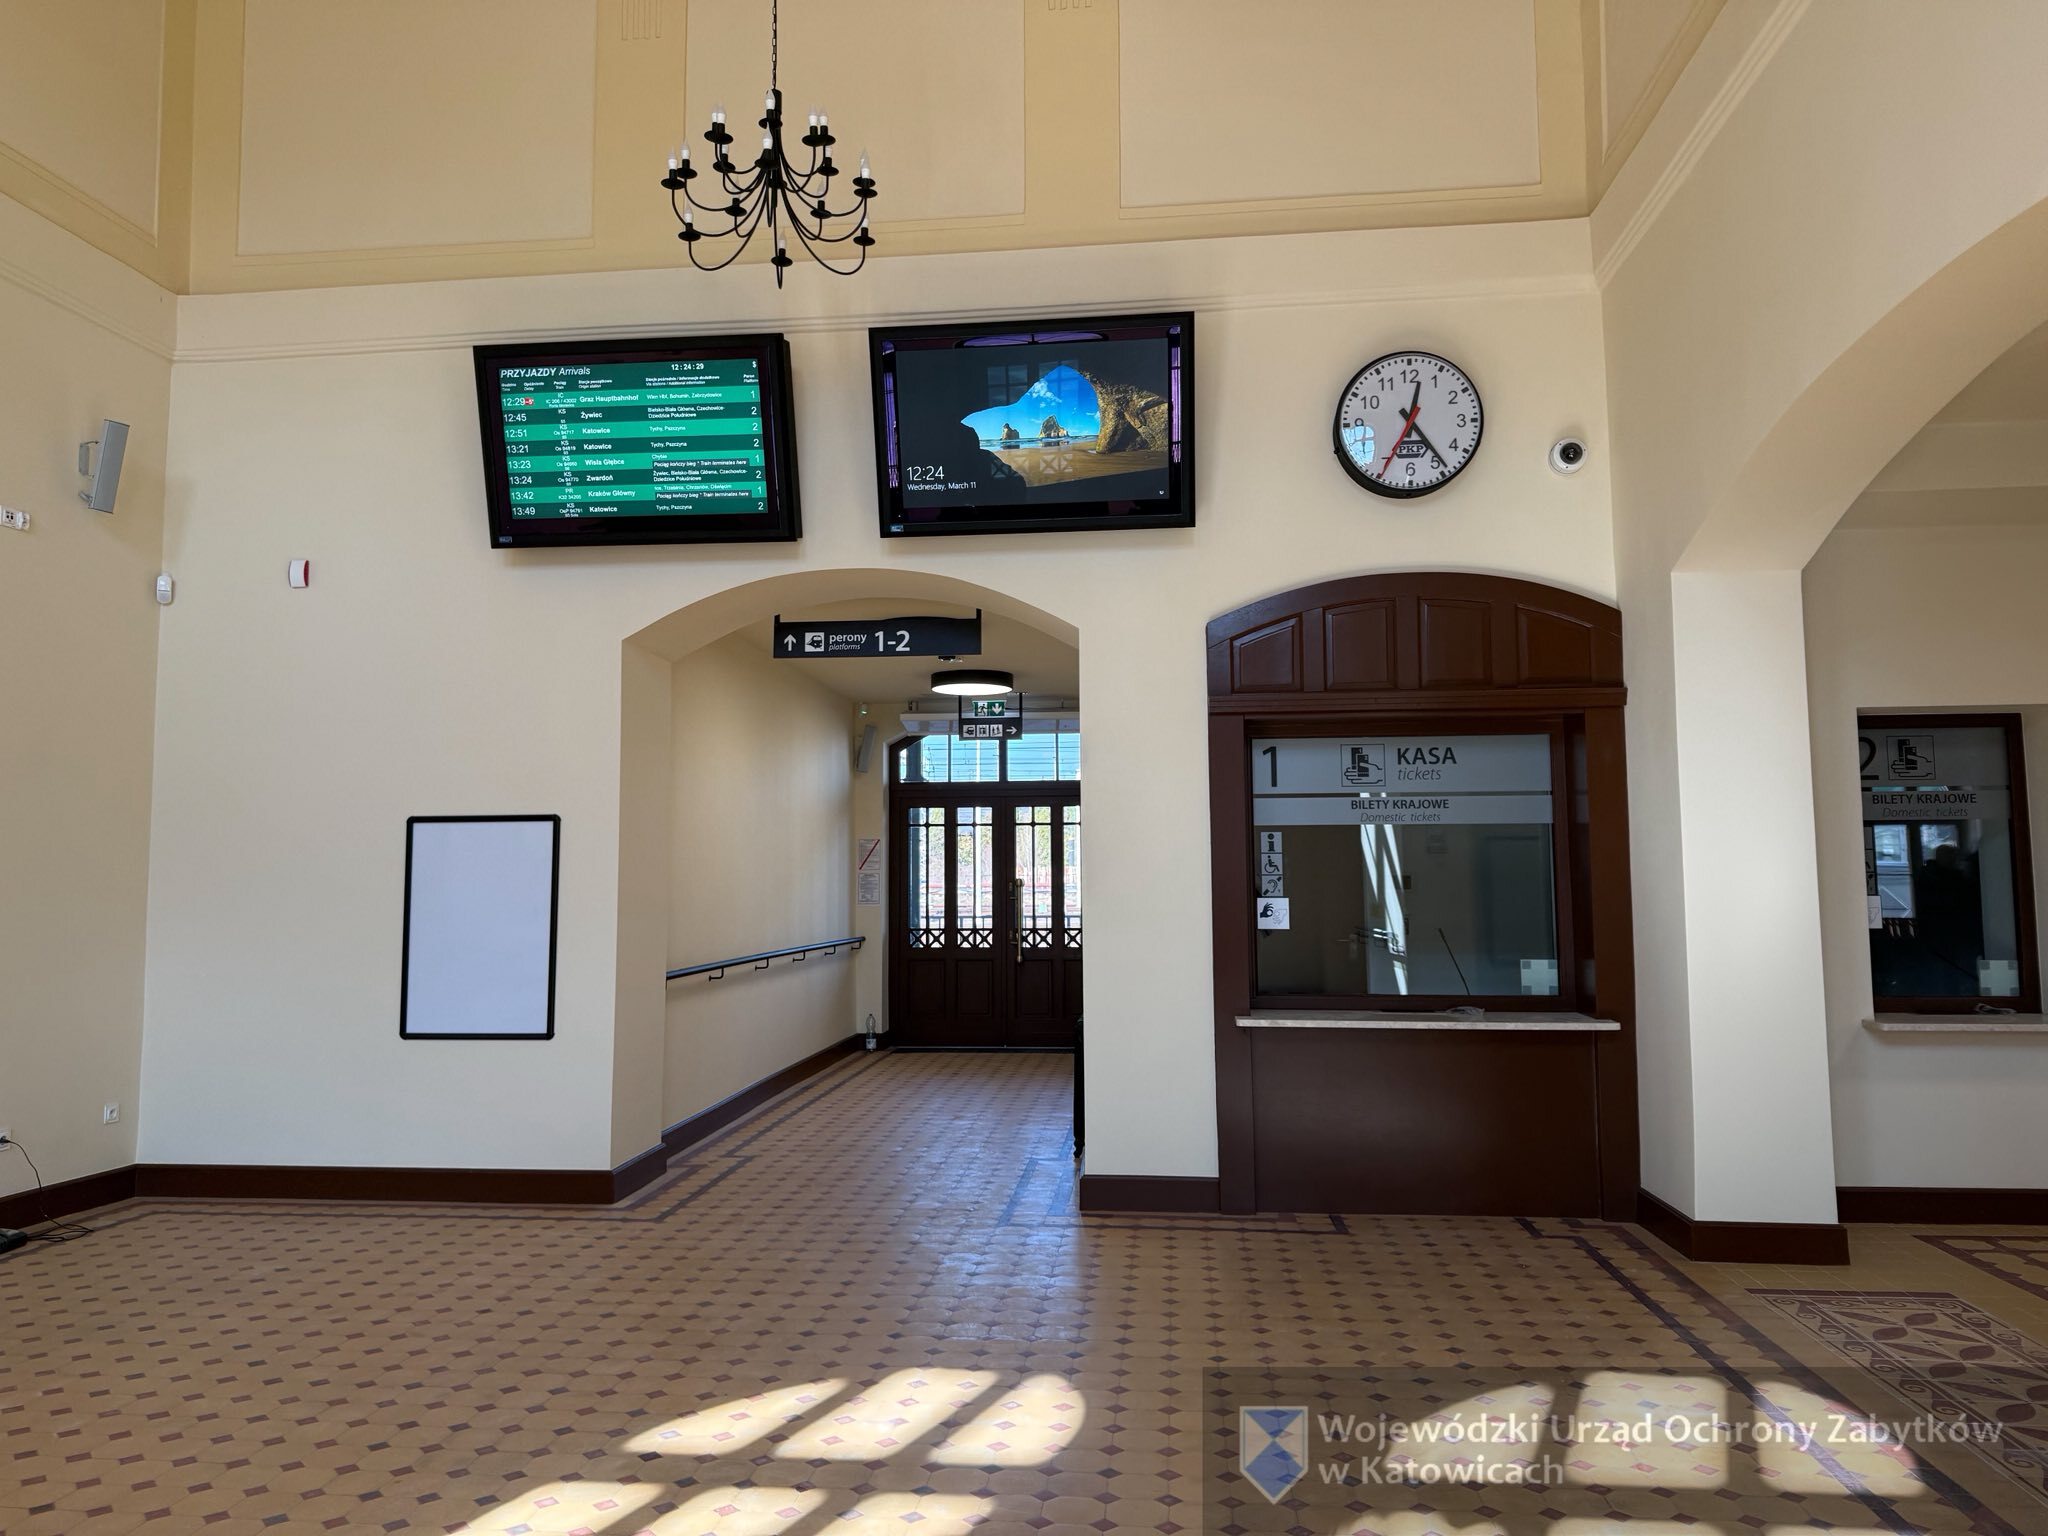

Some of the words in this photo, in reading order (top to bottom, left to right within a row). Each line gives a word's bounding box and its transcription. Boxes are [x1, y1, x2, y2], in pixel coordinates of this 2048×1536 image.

[500, 368, 557, 378] PRZYJAZDY
[559, 366, 591, 376] Arrivals
[1400, 369, 1419, 384] 12
[1378, 377, 1394, 391] 11
[1430, 374, 1438, 388] 1
[596, 394, 639, 403] Hauptbahnhof
[750, 390, 755, 398] 1
[1448, 390, 1458, 405] 2
[502, 398, 525, 406] 12:29
[1360, 395, 1380, 410] 10
[580, 411, 602, 420] Żywiec
[751, 406, 757, 415] 2
[504, 414, 527, 422] 12:45
[1456, 413, 1467, 428] 3
[752, 422, 758, 431] 2
[505, 429, 528, 438] 12:51
[754, 438, 760, 447] 2
[1448, 438, 1459, 452] 4
[506, 444, 529, 454] 13:21
[1398, 445, 1424, 454] PKP
[603, 458, 624, 466] Głębce
[755, 454, 760, 462] 1
[1430, 456, 1441, 470] 5
[508, 460, 531, 469] 13:23
[1405, 462, 1416, 476] 6
[756, 470, 762, 479] 2
[906, 466, 944, 480] 12:24
[509, 476, 532, 484] 13:24
[758, 486, 762, 494] 1
[907, 483, 947, 492] Wednesday,
[948, 482, 969, 490] March
[511, 492, 534, 500] 13:42
[758, 501, 764, 510] 2
[513, 507, 536, 516] 13:49
[829, 633, 867, 644] perony
[874, 630, 911, 652] 1-2
[828, 643, 861, 652] platforms
[1396, 746, 1458, 765] KASA
[1262, 745, 1279, 788] 1
[1397, 767, 1442, 781] tickets
[1350, 800, 1390, 810] BILETY
[1392, 798, 1450, 810] KRAJOWE
[1872, 794, 1914, 805] BILETY
[1916, 793, 1978, 804] KRAJOWE
[1360, 811, 1406, 823] Domestic
[1410, 811, 1442, 823] tickets
[1882, 807, 1932, 818] Domestic
[1936, 806, 1969, 818] tickets
